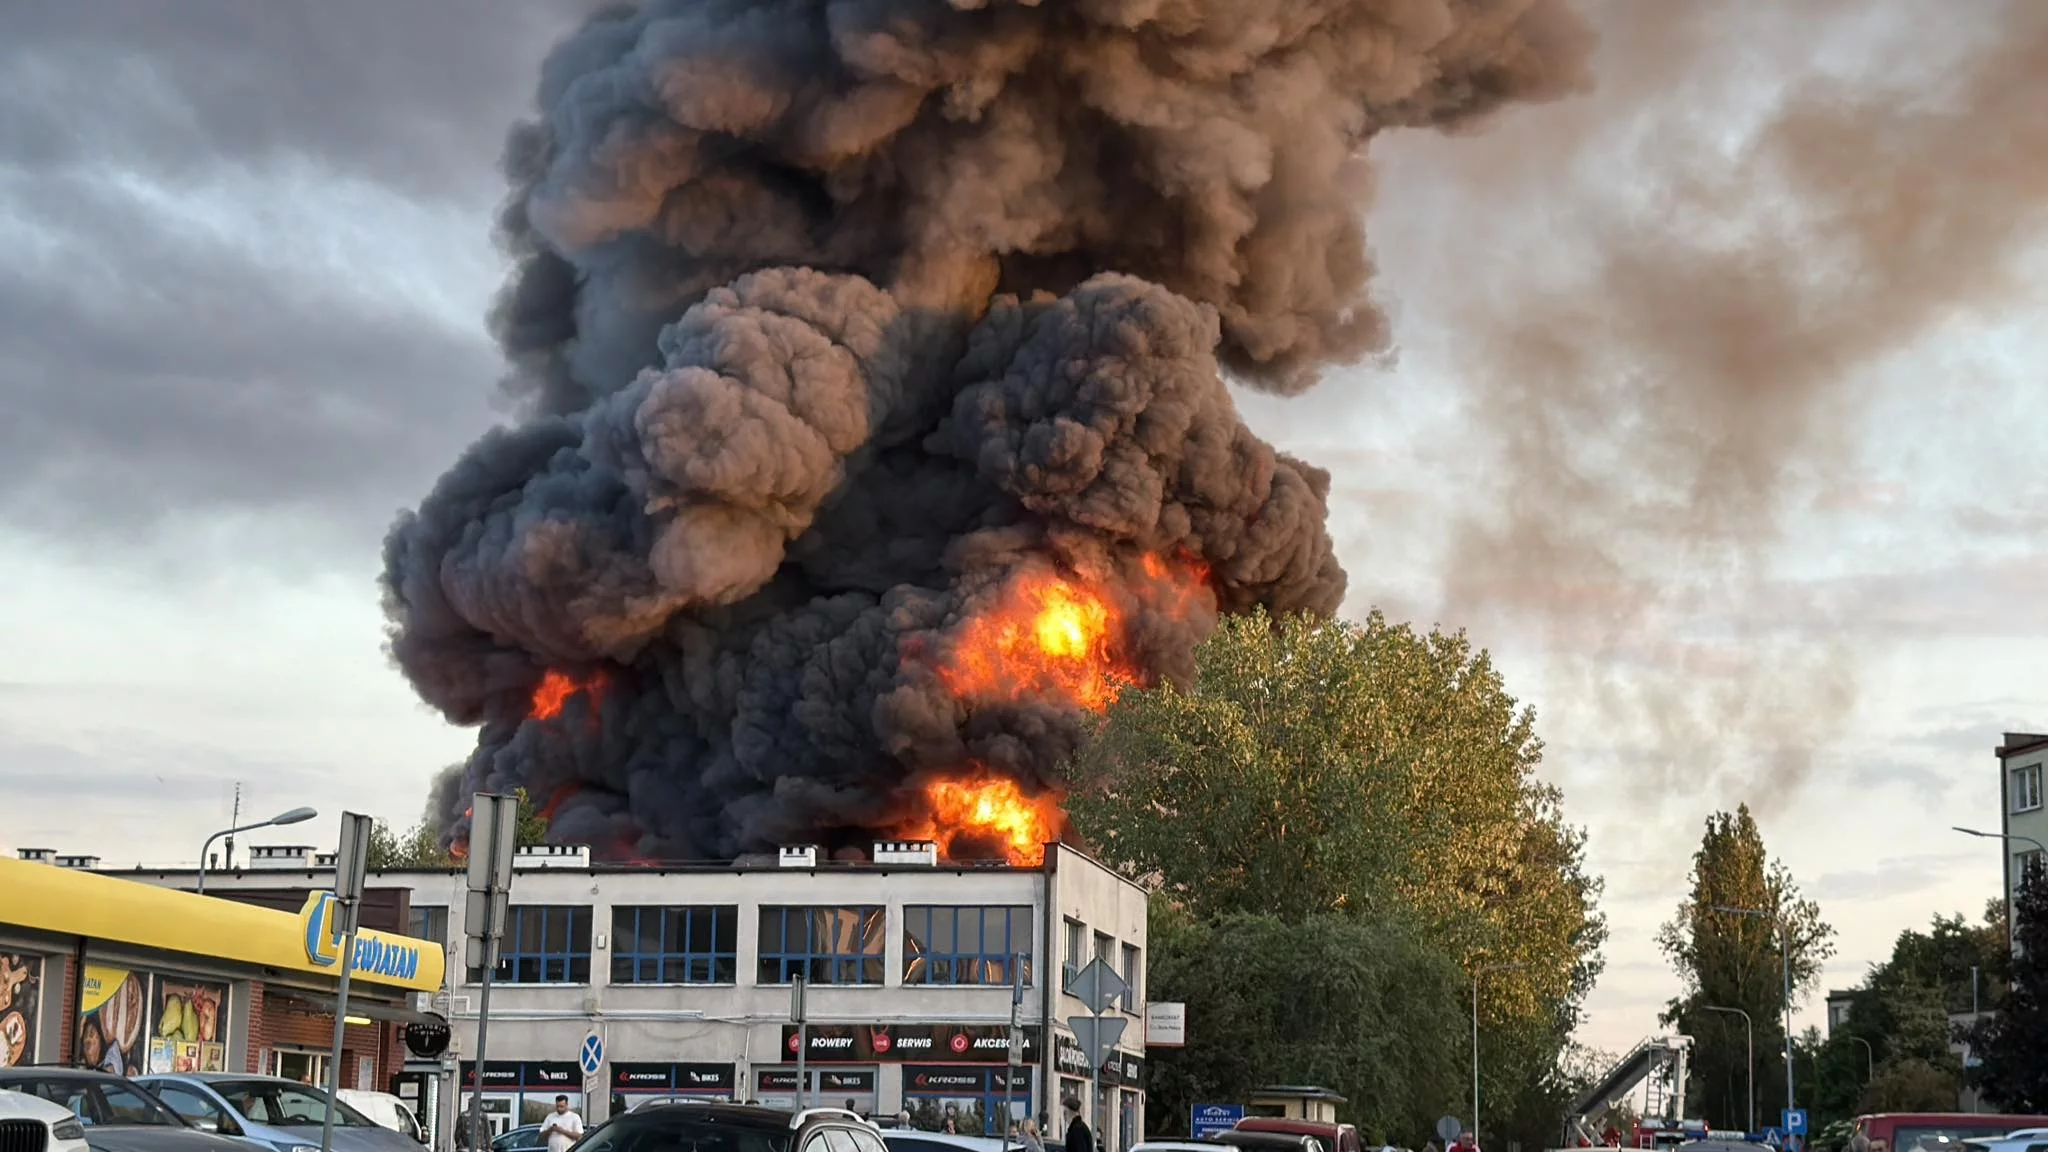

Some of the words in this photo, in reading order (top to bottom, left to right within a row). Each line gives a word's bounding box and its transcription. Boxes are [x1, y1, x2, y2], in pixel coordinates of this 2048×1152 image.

[811, 1038, 853, 1048] ROWERY
[896, 1038, 932, 1048] SERWIS
[973, 1038, 1031, 1048] AKCESA
[550, 1072, 568, 1080] BIKES
[629, 1073, 667, 1081] KROSS
[701, 1074, 719, 1082] BIKES
[928, 1075, 977, 1084] KROSS
[1012, 1076, 1026, 1085] KES
[842, 1077, 861, 1086] BIKES
[1788, 1112, 1802, 1130] P
